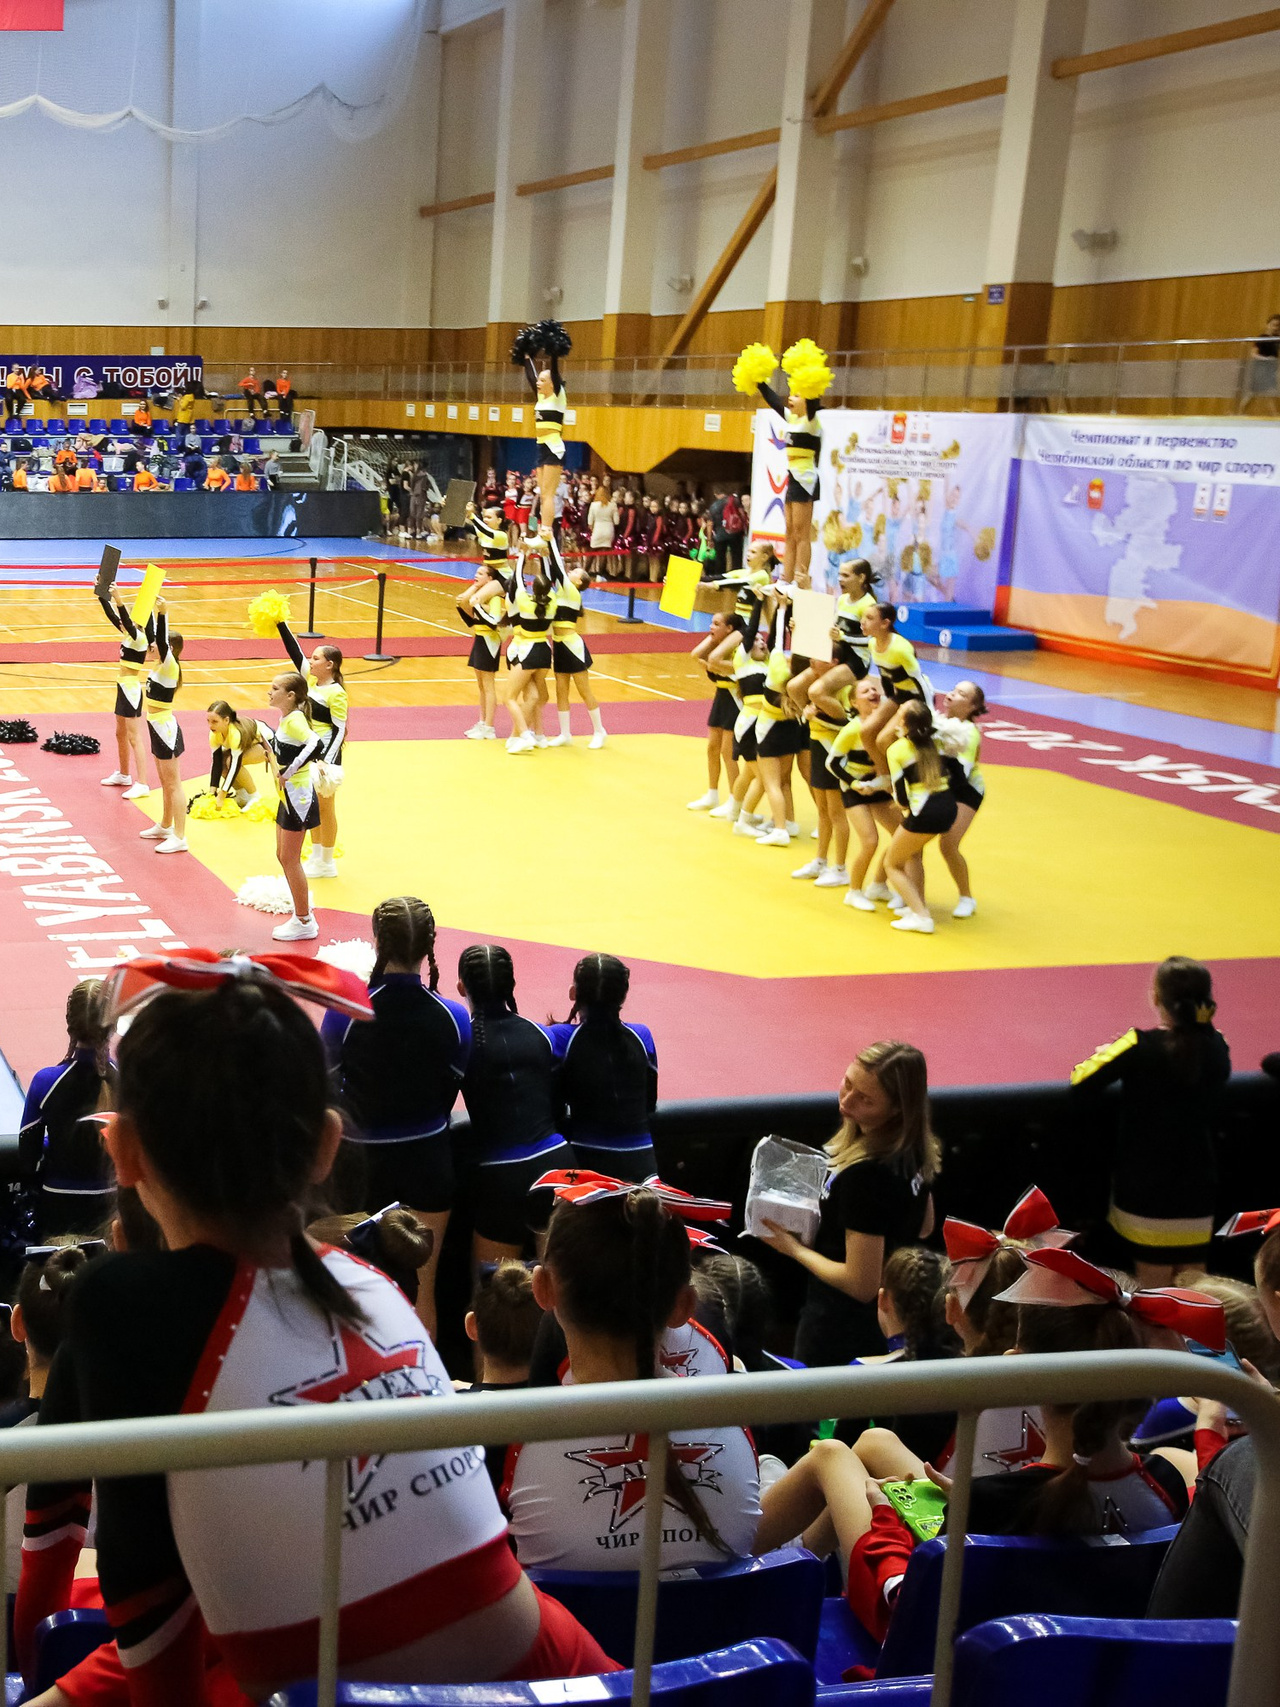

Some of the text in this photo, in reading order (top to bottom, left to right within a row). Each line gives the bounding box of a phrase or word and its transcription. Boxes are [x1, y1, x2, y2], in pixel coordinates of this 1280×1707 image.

[103, 362, 202, 389] ТОБОЙ!
[1071, 429, 1141, 446] Чемпионат
[1155, 435, 1238, 450] первенство
[1038, 449, 1276, 479] Челябинской области по чир спорту
[340, 1370, 418, 1401] LEX
[410, 1449, 477, 1496] СПОР
[595, 1532, 640, 1550] ЧИР
